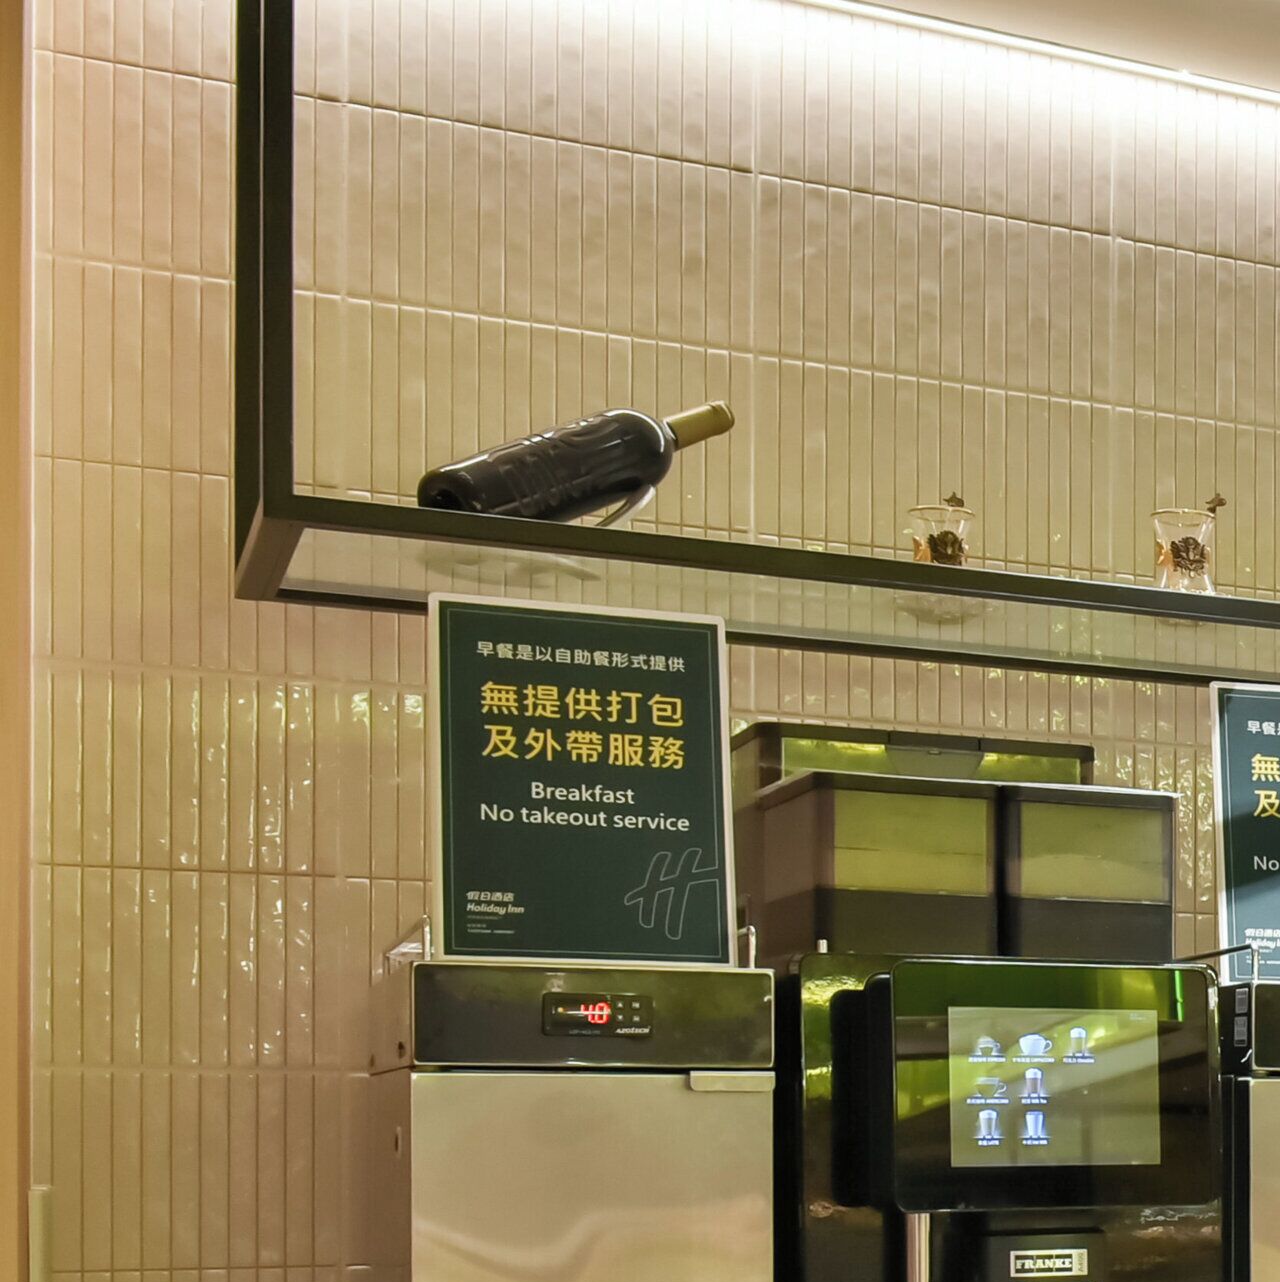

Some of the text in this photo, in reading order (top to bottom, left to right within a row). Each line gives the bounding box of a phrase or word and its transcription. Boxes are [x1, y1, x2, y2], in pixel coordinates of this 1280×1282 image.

[476, 641, 686, 673] 早餐是以自助餐形式提供
[480, 681, 684, 728] 無提供打包
[482, 724, 686, 770] 及外帶服務
[531, 782, 635, 805] Breakfast
[480, 803, 690, 832] No takeout service
[1253, 856, 1280, 872] No
[466, 902, 525, 915] Holiday Inn
[1015, 1258, 1073, 1270] FRANKE
